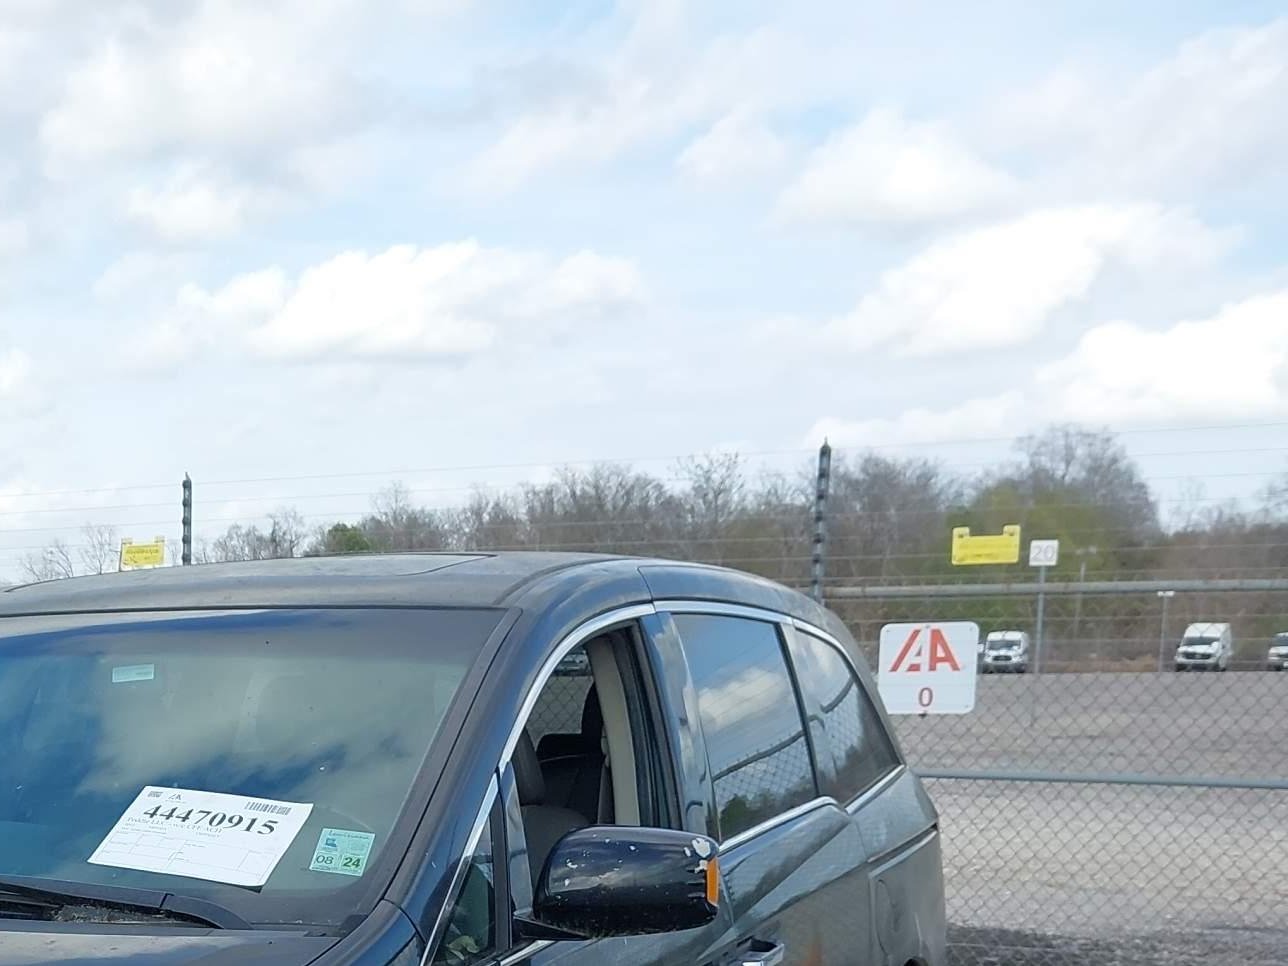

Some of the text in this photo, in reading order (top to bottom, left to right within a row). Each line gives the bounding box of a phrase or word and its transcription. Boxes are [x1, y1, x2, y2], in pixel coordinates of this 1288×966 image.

[918, 686, 934, 708] 0
[143, 804, 279, 835] 44470915
[315, 854, 335, 865] 08
[343, 856, 362, 869] 24
